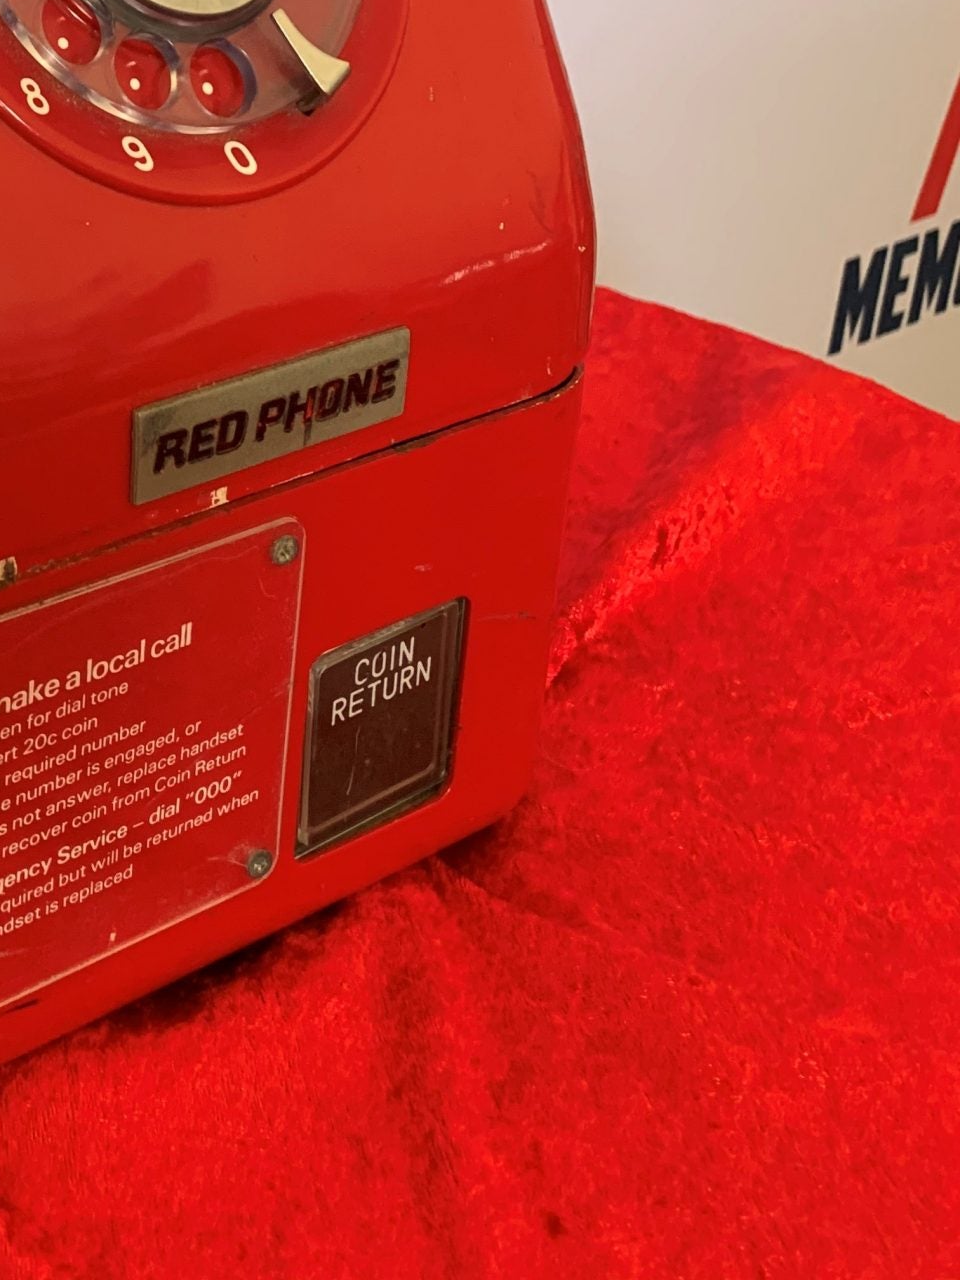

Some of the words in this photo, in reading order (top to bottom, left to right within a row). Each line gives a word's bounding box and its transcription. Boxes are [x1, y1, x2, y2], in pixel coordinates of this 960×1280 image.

[20, 77, 50, 116] 8
[121, 135, 154, 172] 9
[224, 140, 258, 176] 0
[153, 409, 249, 474] RED
[256, 359, 401, 444] PHONE
[65, 671, 81, 690] a
[86, 639, 146, 683] local
[150, 621, 193, 658] call
[354, 636, 415, 686] COIN
[27, 709, 52, 730] for
[56, 694, 86, 719] dial
[90, 682, 129, 706] tone
[331, 657, 432, 727] RETURN
[5, 745, 77, 787] required
[81, 721, 147, 756] number
[15, 769, 82, 806] number
[87, 762, 100, 777] is
[104, 728, 180, 770] engaged,
[185, 720, 202, 736] or
[23, 733, 57, 756] 20c
[62, 716, 98, 740] coin
[2, 821, 68, 858] recover
[72, 804, 107, 828] coin
[112, 788, 150, 811] from
[154, 769, 190, 792] Coin
[195, 745, 247, 776] Return
[12, 808, 40, 830] not
[45, 781, 112, 816] answer,
[117, 754, 176, 787] replace
[180, 723, 244, 760] handset
[57, 824, 128, 865] Service
[149, 798, 180, 825] dial
[59, 865, 87, 887] but
[91, 849, 119, 873] will
[123, 838, 143, 859] be
[146, 808, 213, 848] returned
[216, 789, 259, 816] when
[45, 900, 59, 915] is
[62, 863, 134, 907] replaced
